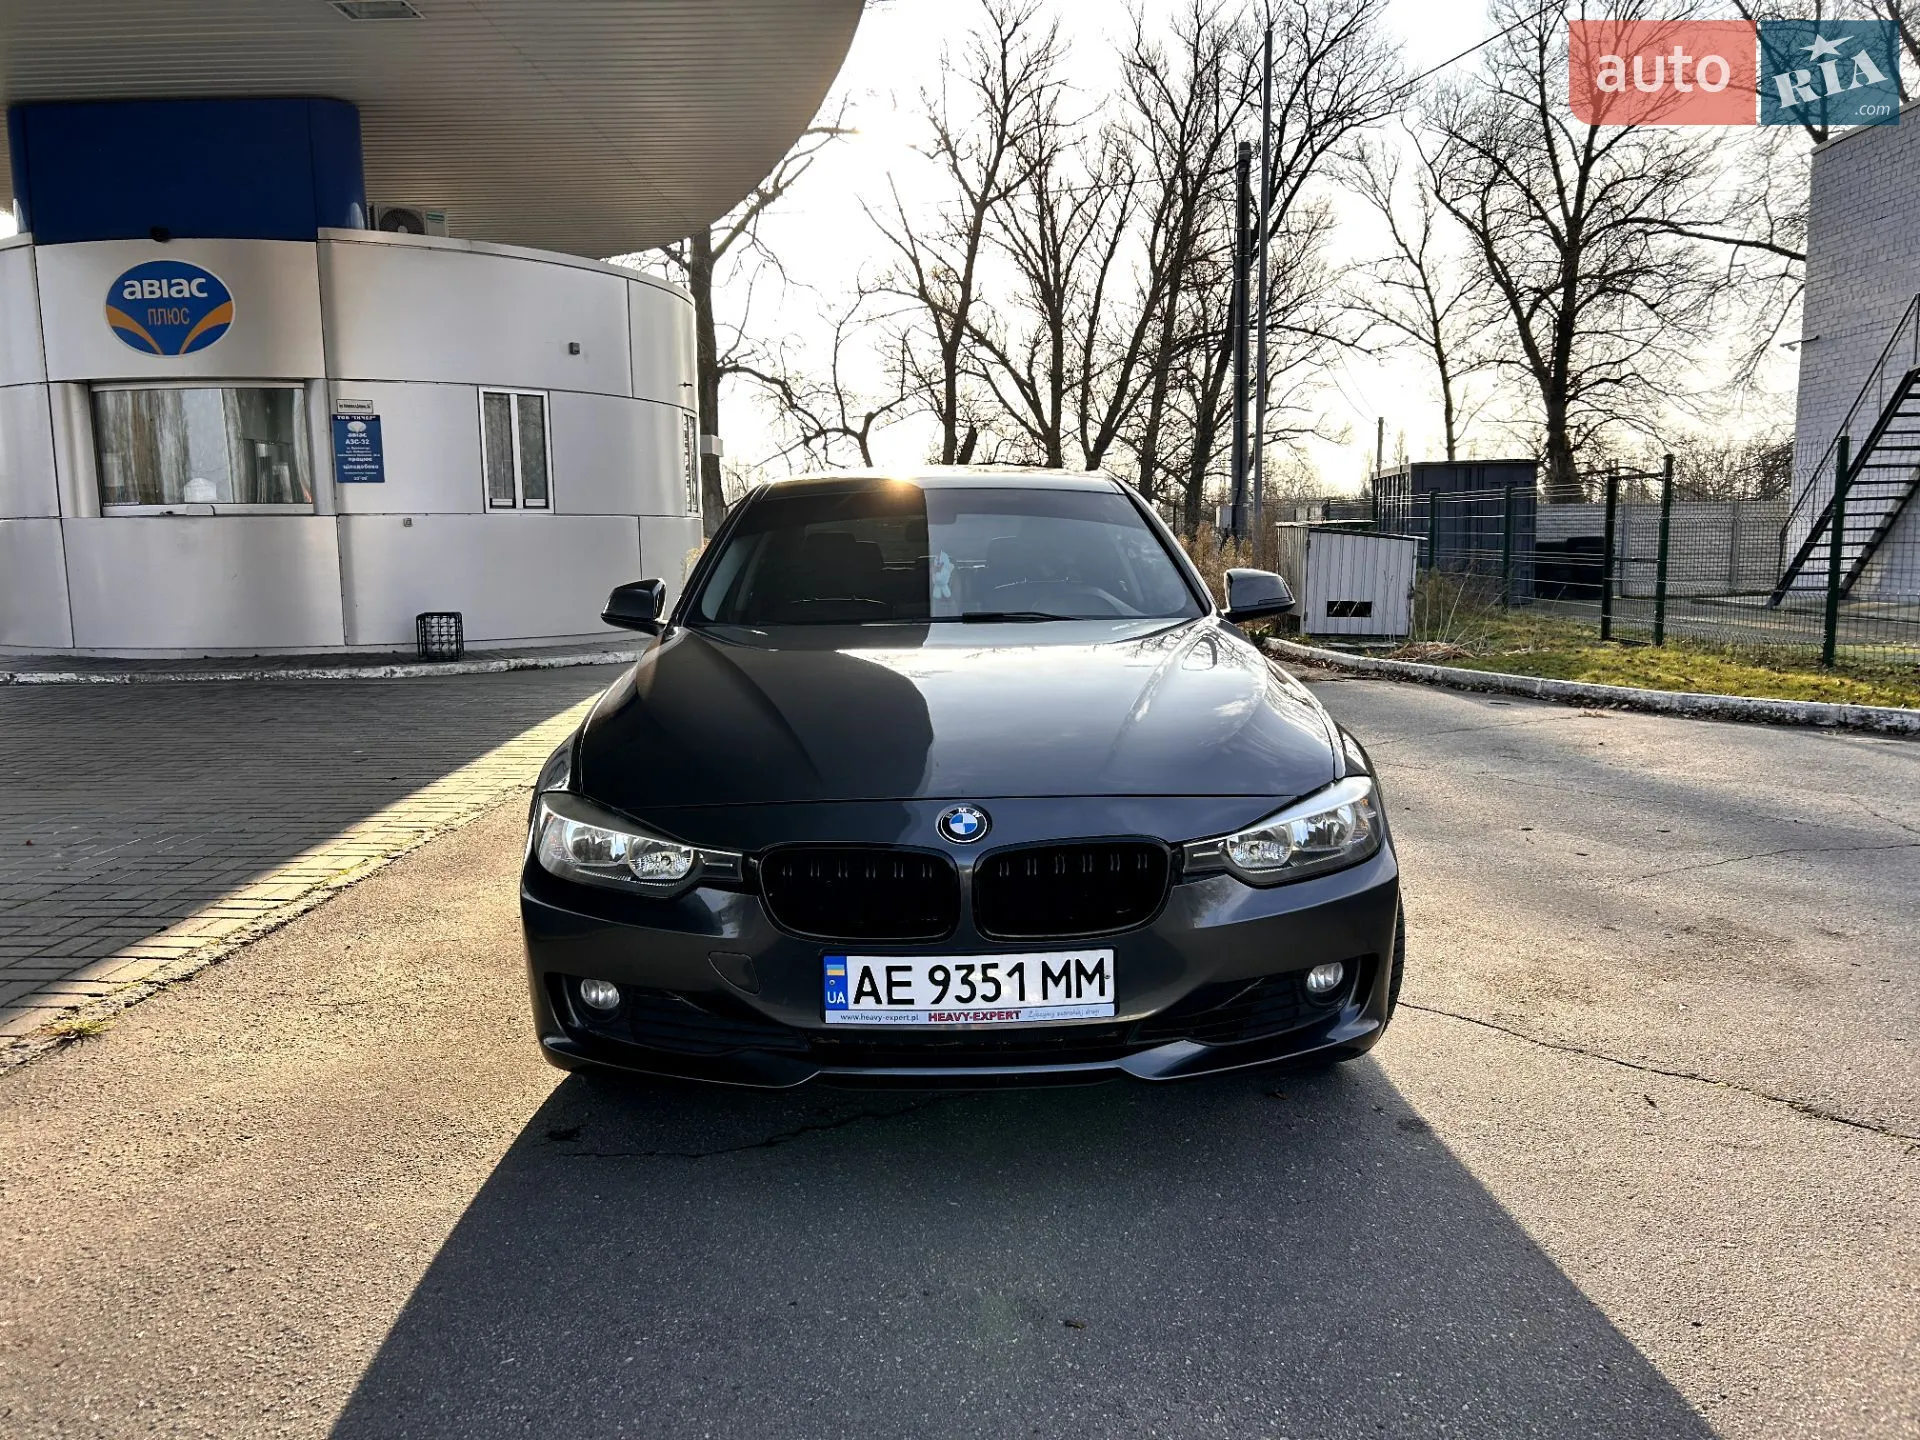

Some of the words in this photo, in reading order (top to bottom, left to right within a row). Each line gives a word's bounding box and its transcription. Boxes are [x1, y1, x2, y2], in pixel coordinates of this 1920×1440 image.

[853, 965, 915, 1006] AE
[927, 961, 1026, 1005] 9351
[1041, 957, 1106, 1001] MM
[826, 991, 846, 1004] UA
[840, 1012, 919, 1023] www.heavy-expert.pl
[928, 1010, 1022, 1022] HEAVY-EXPERT
